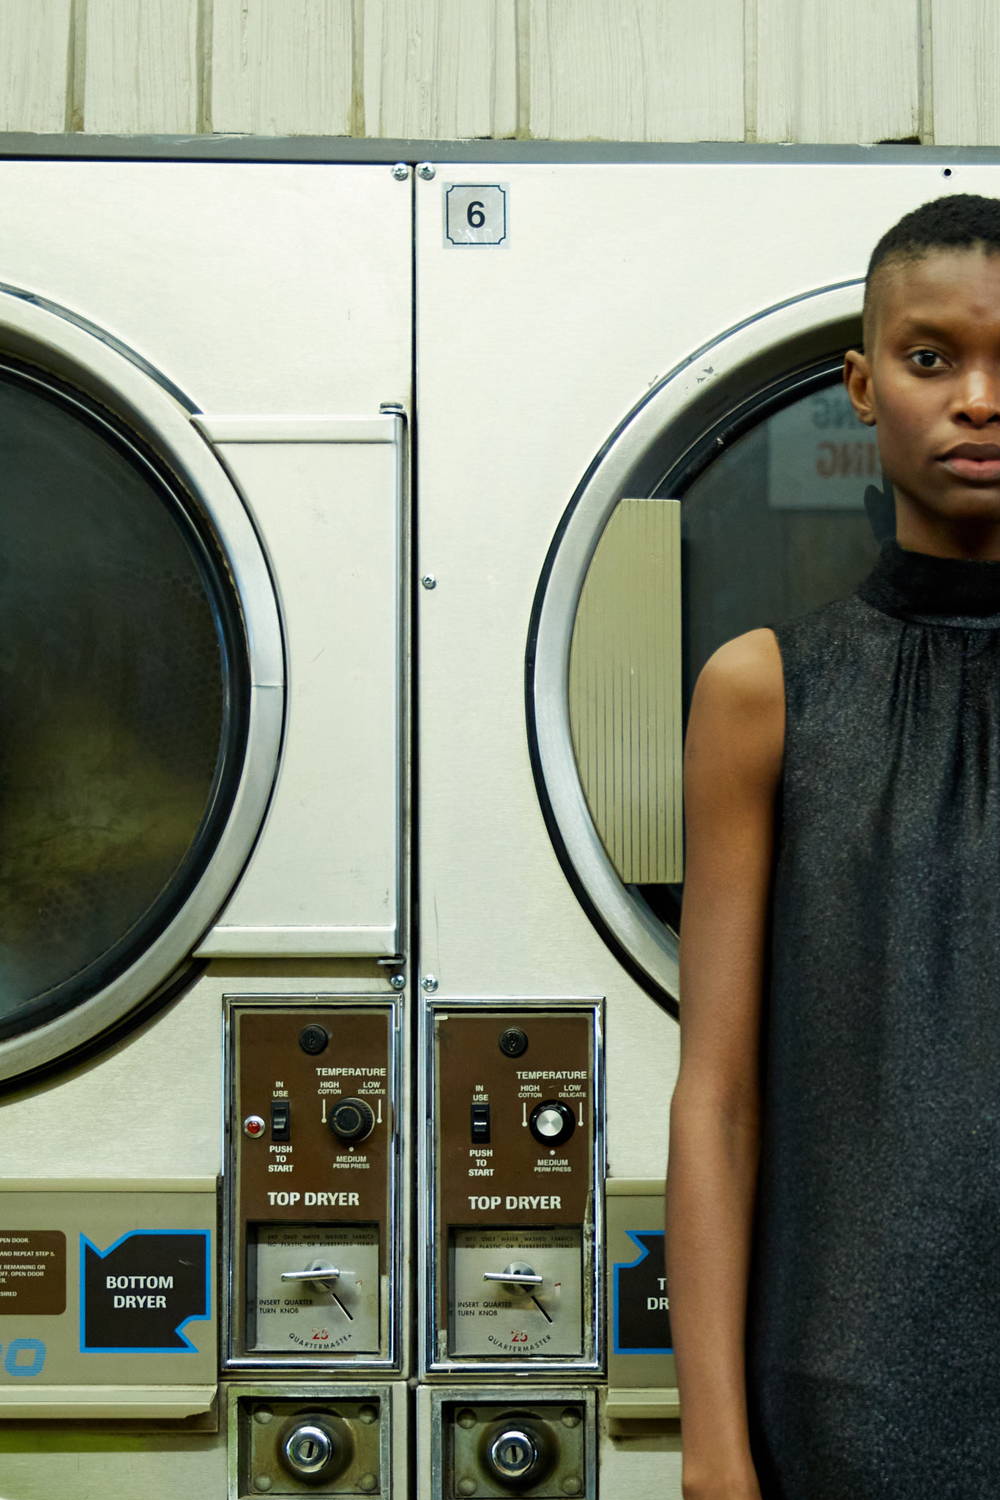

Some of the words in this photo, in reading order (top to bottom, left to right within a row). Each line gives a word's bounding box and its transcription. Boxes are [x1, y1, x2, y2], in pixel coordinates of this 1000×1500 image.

[467, 201, 486, 229] 6
[316, 1067, 387, 1076] TEMPERATURE
[516, 1071, 587, 1080] TEMPERATURE
[520, 1084, 540, 1092] HIGH
[563, 1084, 582, 1092] LOW
[273, 1090, 289, 1098] USE
[269, 1145, 293, 1153] PUSH
[469, 1149, 493, 1157] PUSH
[336, 1155, 367, 1163] MEDIUM
[267, 1192, 300, 1206] TOP
[304, 1192, 360, 1206] DRYER
[468, 1196, 501, 1210] TOP
[505, 1196, 562, 1210] DRYER
[106, 1275, 174, 1289] BOTTOM
[113, 1295, 167, 1309] DRYER
[312, 1328, 329, 1340] 25
[511, 1330, 528, 1343] 25
[488, 1334, 551, 1352] QUARTERMASTER
